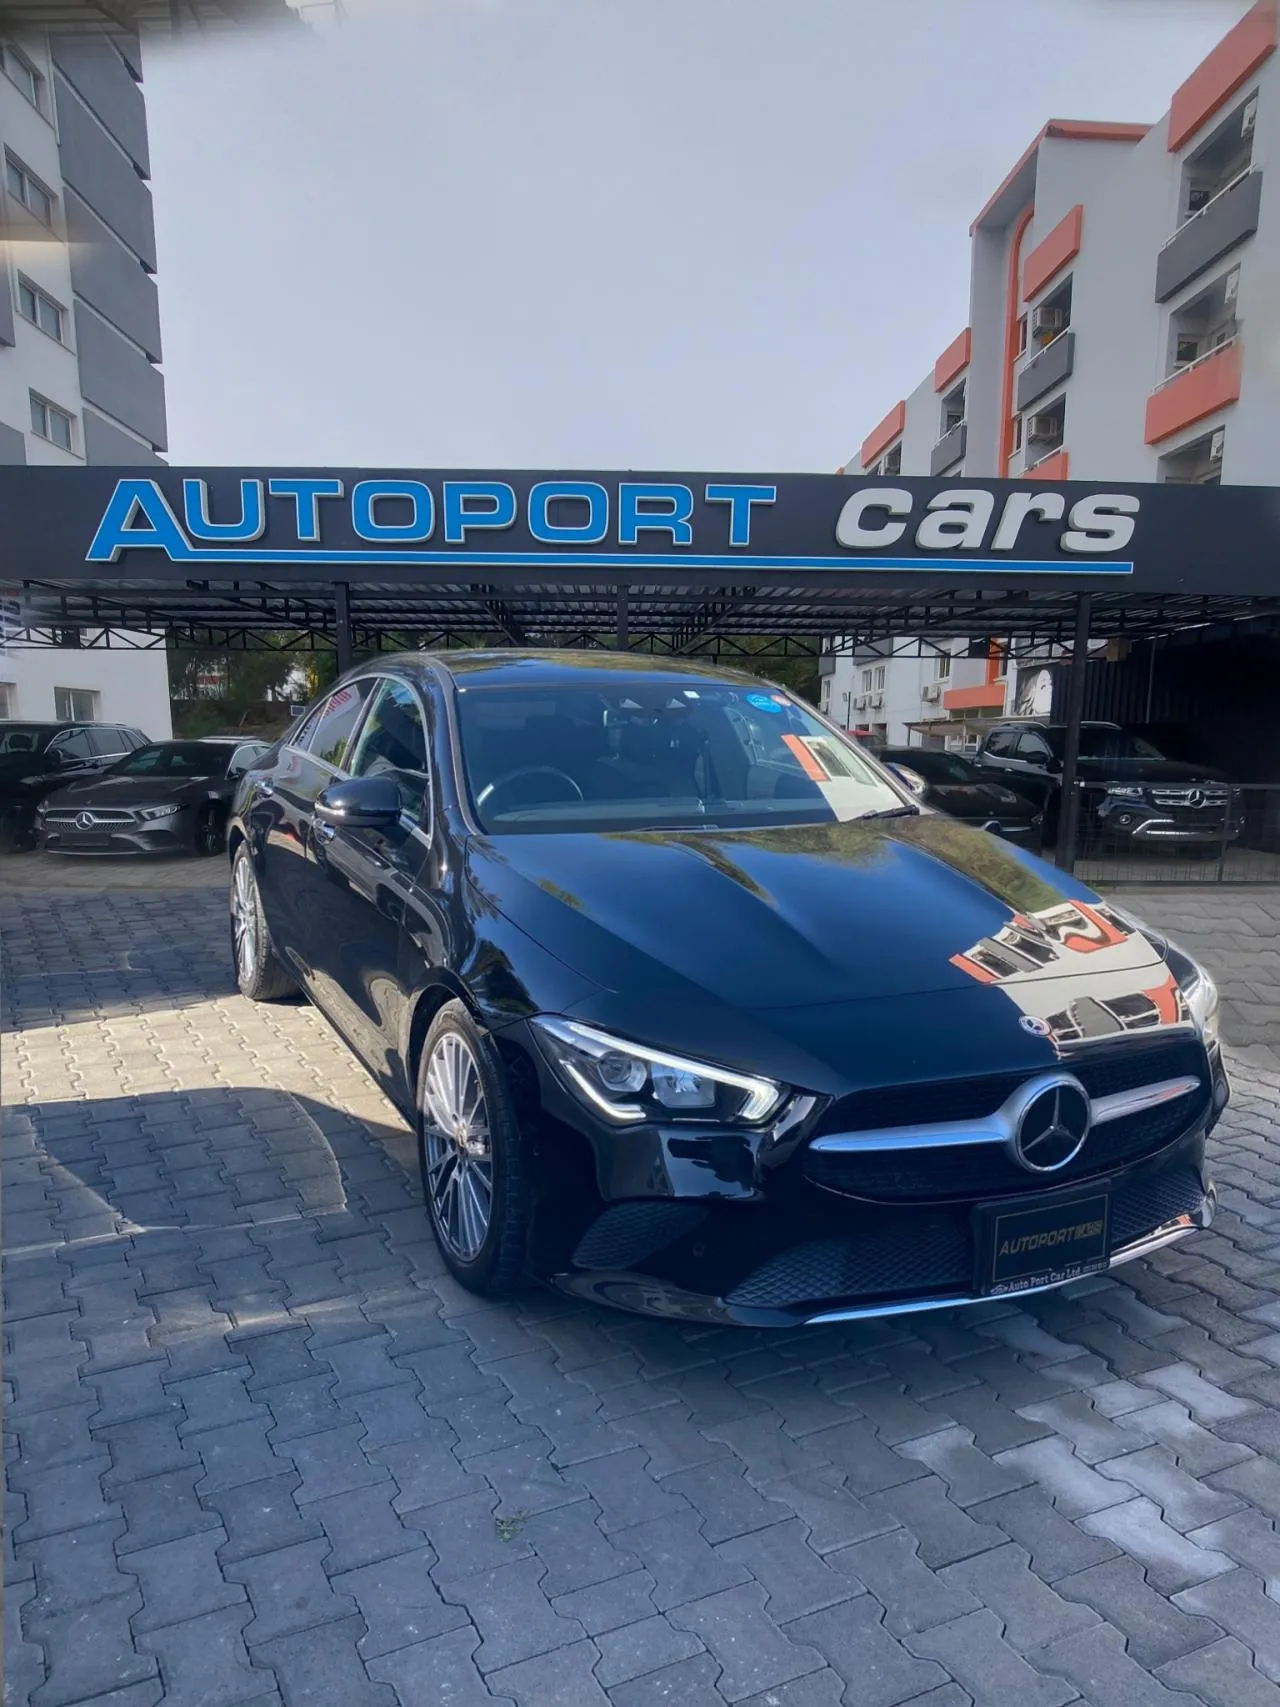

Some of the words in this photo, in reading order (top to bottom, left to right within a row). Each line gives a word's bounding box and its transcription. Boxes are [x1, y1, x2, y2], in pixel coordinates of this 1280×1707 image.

[85, 478, 779, 562] AUTOPORT
[836, 488, 1141, 553] cars
[998, 1226, 1076, 1257] AUTOPORT
[1008, 1280, 1029, 1292] Auto
[1030, 1275, 1049, 1287] Port
[1050, 1271, 1065, 1282] Car
